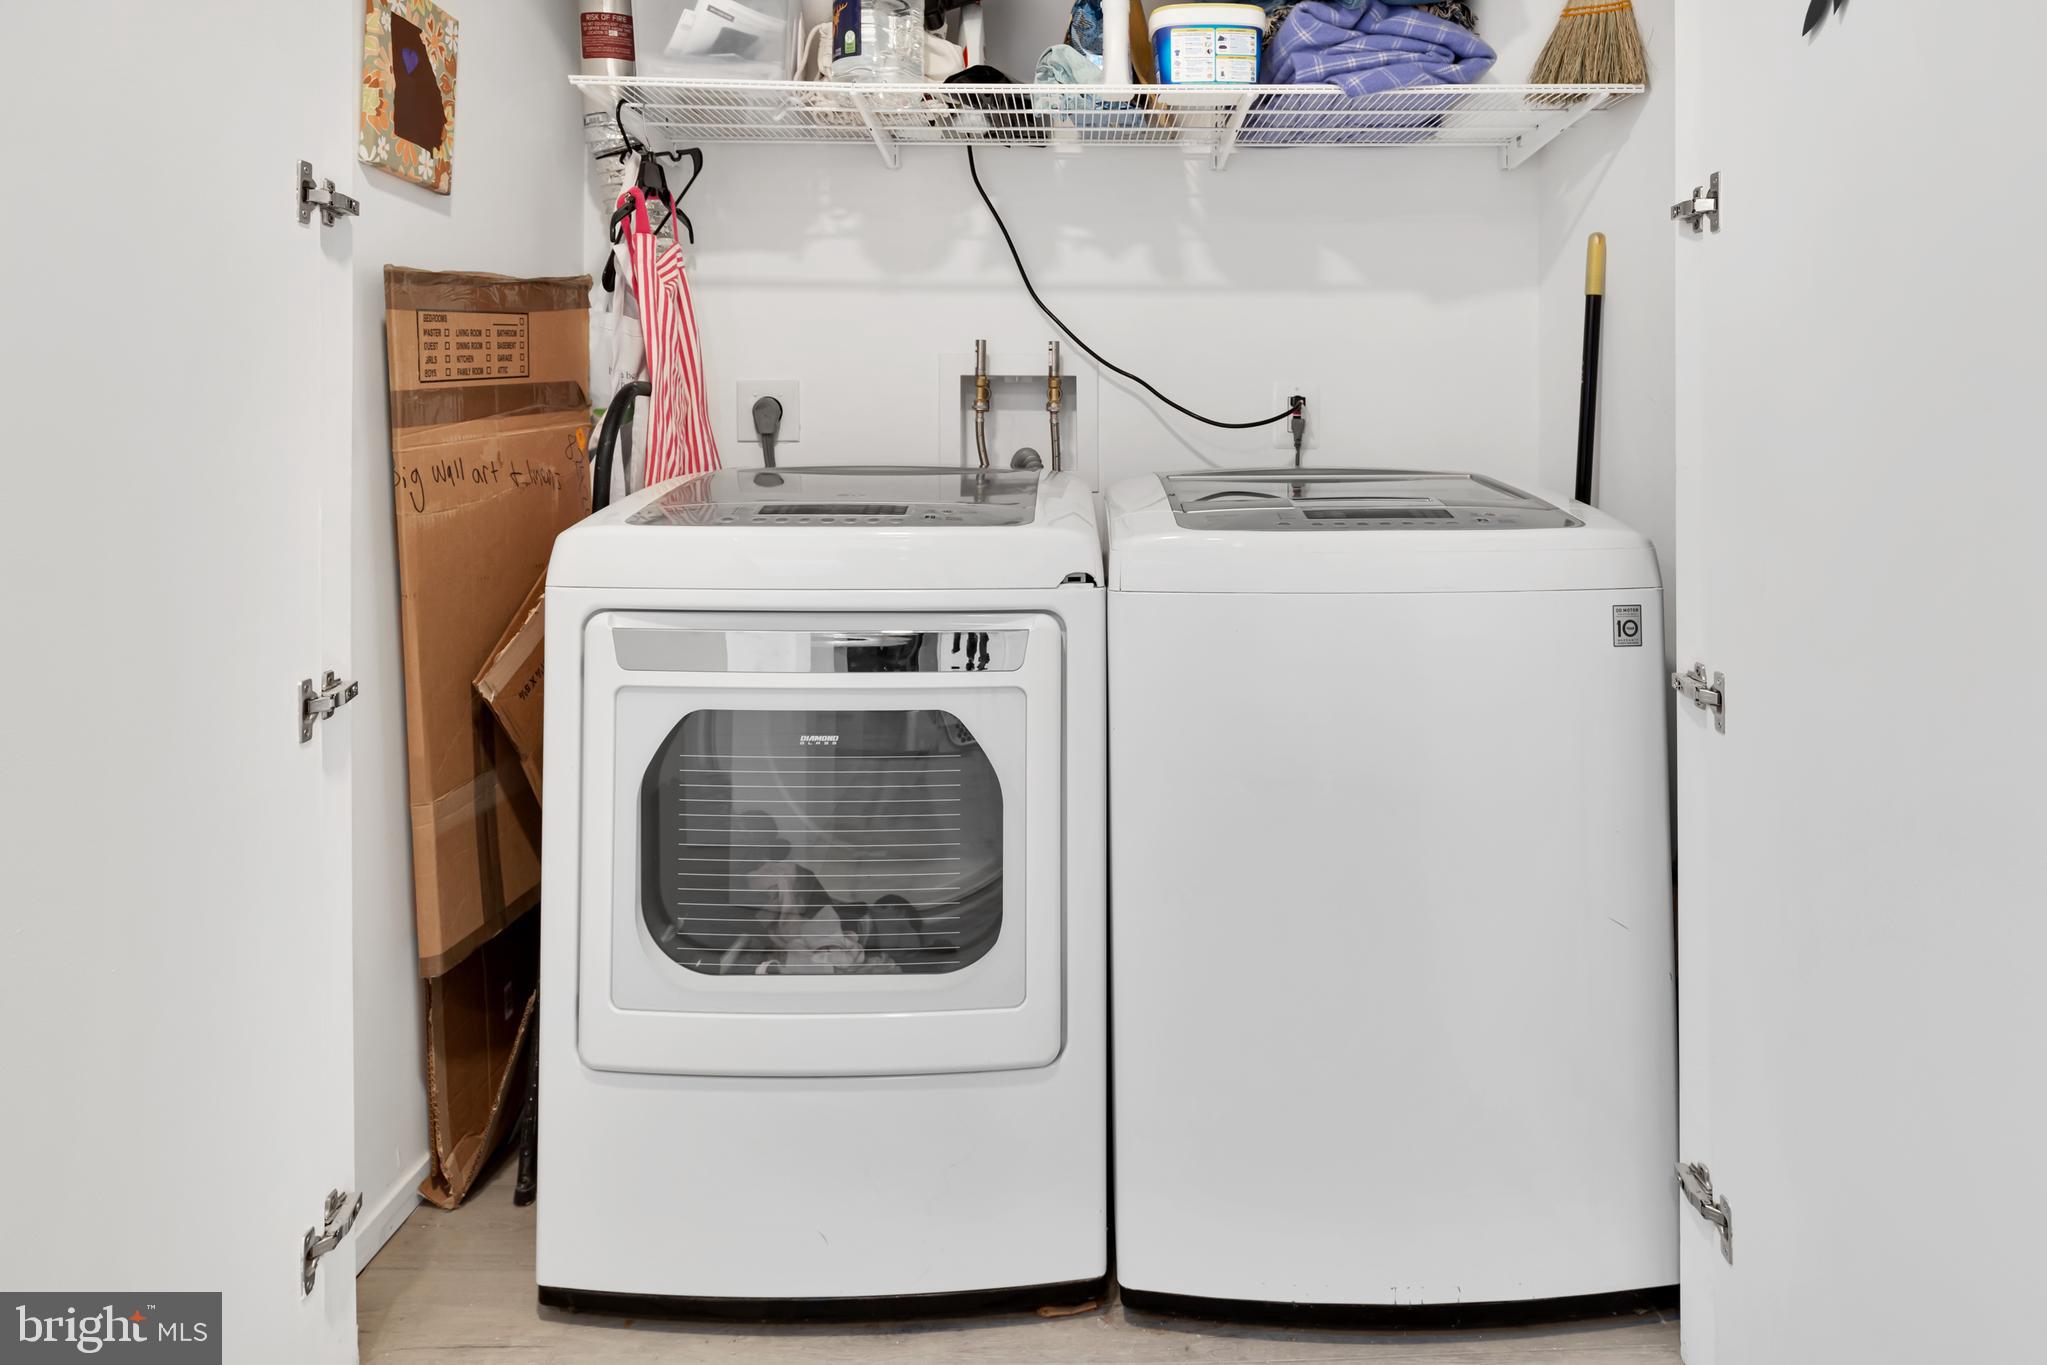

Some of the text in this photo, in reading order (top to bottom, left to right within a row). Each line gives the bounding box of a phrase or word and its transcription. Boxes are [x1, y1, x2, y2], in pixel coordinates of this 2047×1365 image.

[612, 14, 627, 22] FIRE
[423, 314, 447, 323] BEDROOMS
[423, 328, 442, 337] MASTER
[456, 329, 482, 337] LIVING ROOM
[497, 329, 517, 337] BATHROOM
[456, 342, 483, 350] DINING ROOM
[497, 342, 517, 350] BASEMENT
[457, 355, 474, 363] KITCHEN
[497, 354, 513, 362] GARAGE
[425, 369, 437, 377] BOYS
[457, 368, 484, 376] FAMILY ROOM
[498, 366, 508, 374] ATTIC
[472, 461, 499, 484] art
[1617, 619, 1639, 638] 10
